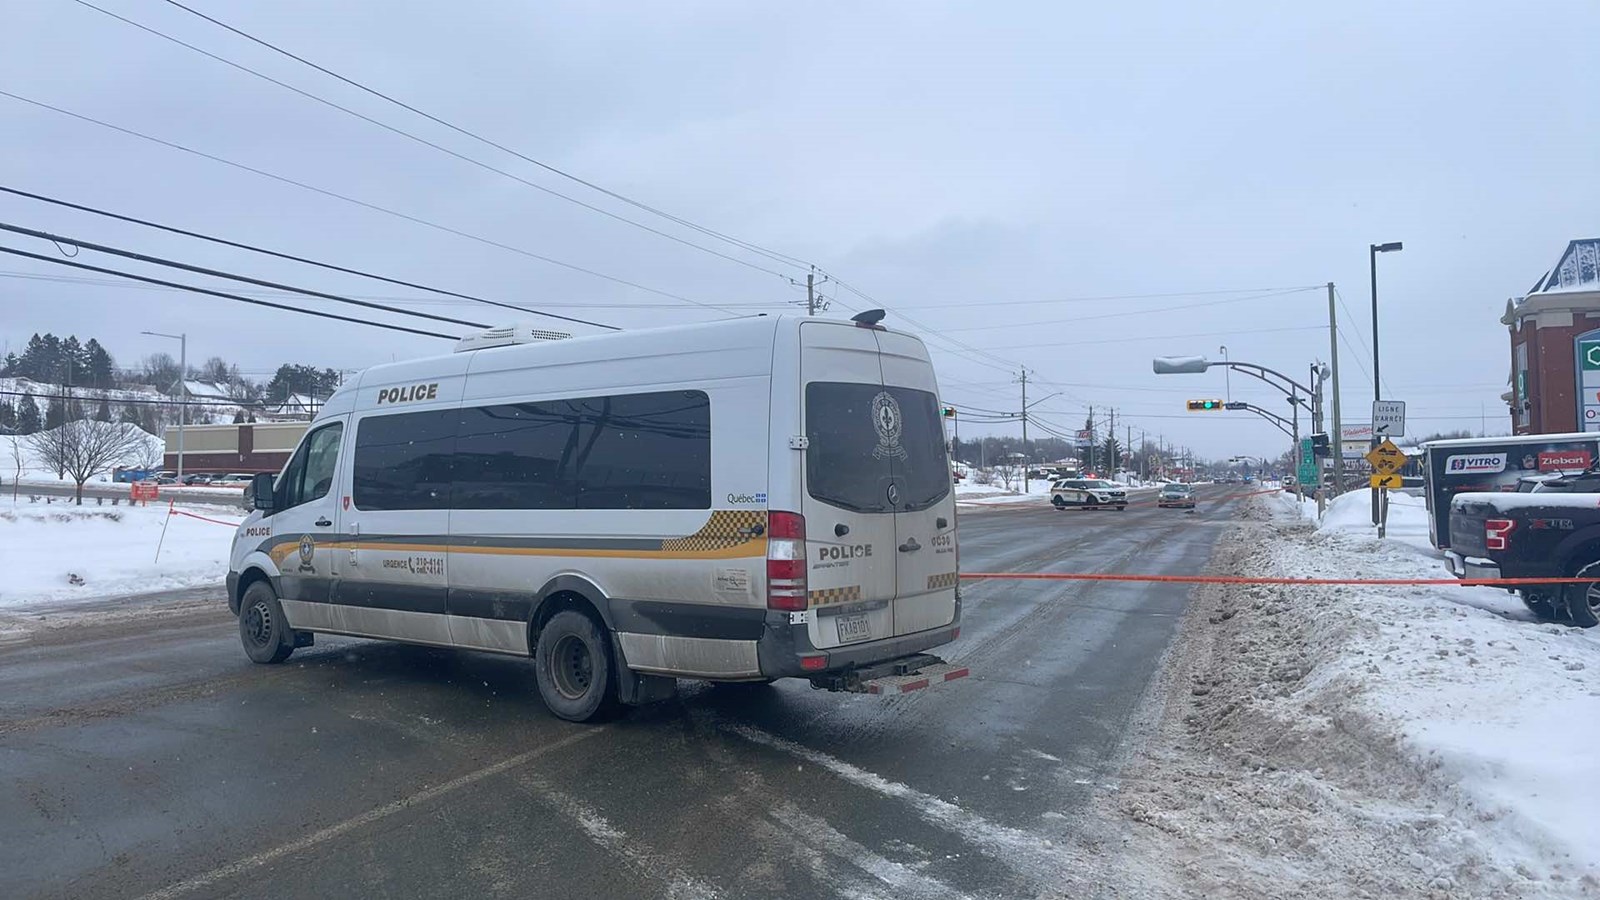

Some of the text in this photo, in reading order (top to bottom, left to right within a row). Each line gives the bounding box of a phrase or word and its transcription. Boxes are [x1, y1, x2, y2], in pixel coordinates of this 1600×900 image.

[377, 383, 438, 404] POLICE
[1467, 457, 1500, 466] VITRO
[1542, 457, 1584, 465] Ziebart
[727, 493, 755, 505] Québec
[246, 527, 270, 536] POLICE
[819, 544, 873, 561] POLICE
[382, 559, 408, 569] URGENCE
[416, 557, 444, 567] 310-4141
